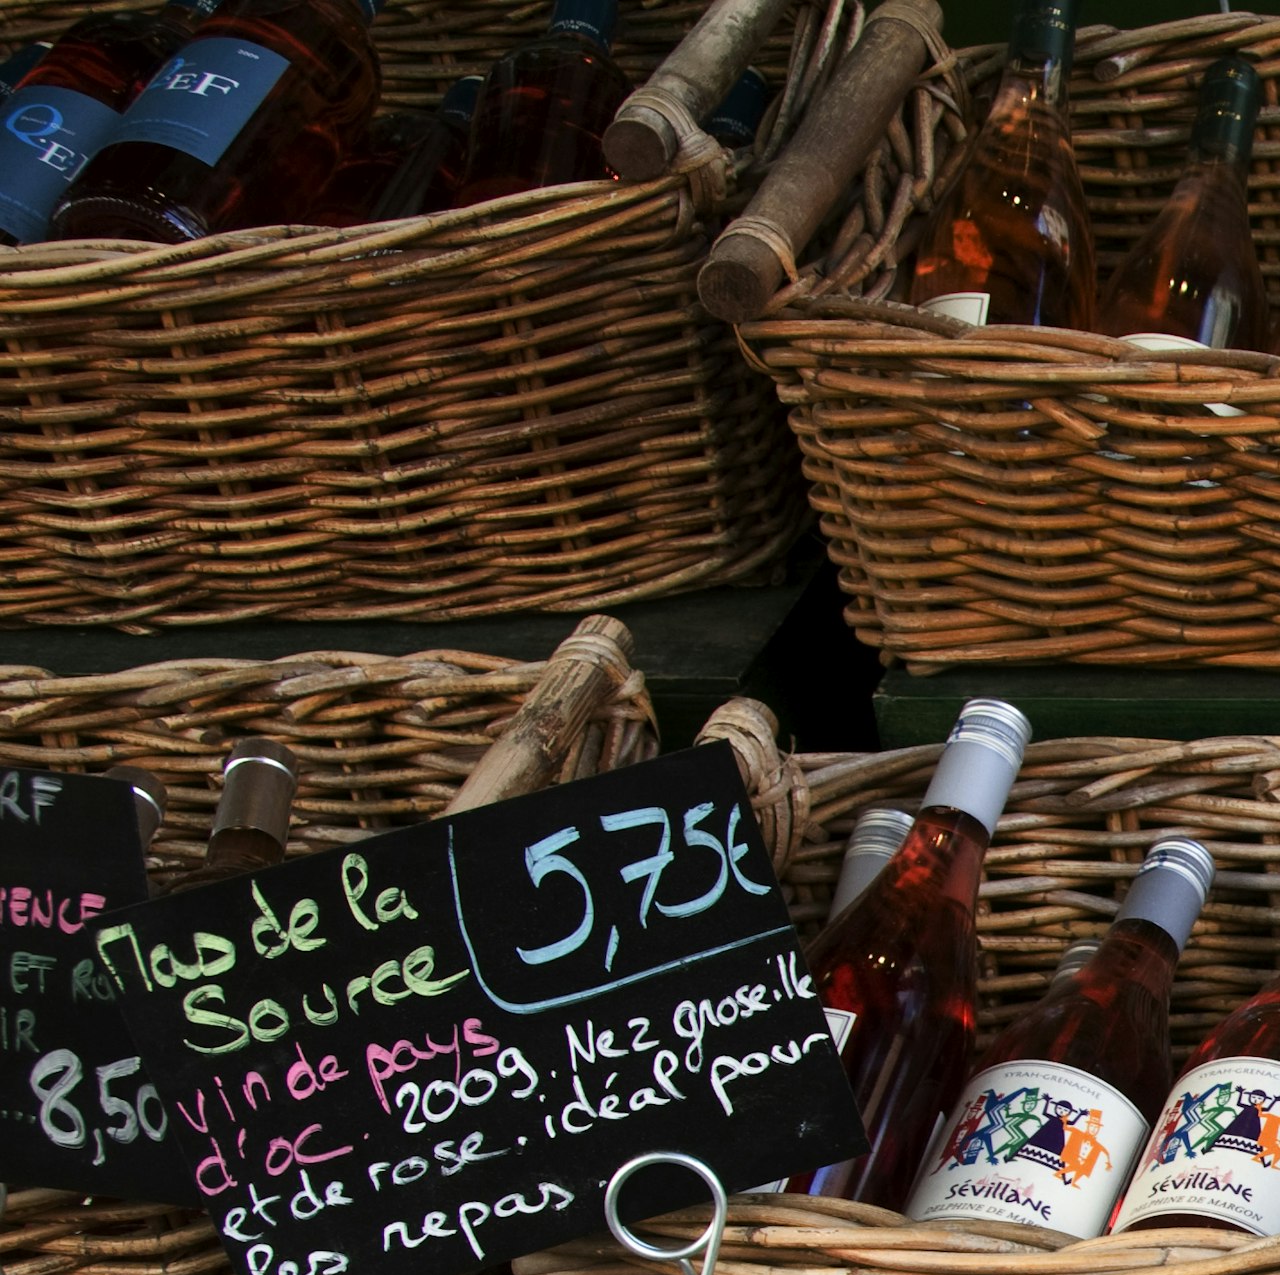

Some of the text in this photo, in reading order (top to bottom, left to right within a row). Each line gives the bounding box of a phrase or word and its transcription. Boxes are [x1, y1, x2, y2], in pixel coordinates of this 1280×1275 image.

[250, 879, 328, 960] de
[340, 851, 419, 931] la
[515, 800, 774, 973] 5,75€
[182, 942, 471, 1055] Source
[29, 1047, 168, 1167] 8,50
[285, 1041, 350, 1101] de
[365, 1016, 500, 1115] pays
[222, 1183, 283, 1242] et
[290, 1163, 354, 1225] de
[710, 1032, 830, 1116] pour
[986, 1206, 1003, 1219] DE
[1190, 1194, 1207, 1206] DE
[1208, 1196, 1266, 1223] MARGON
